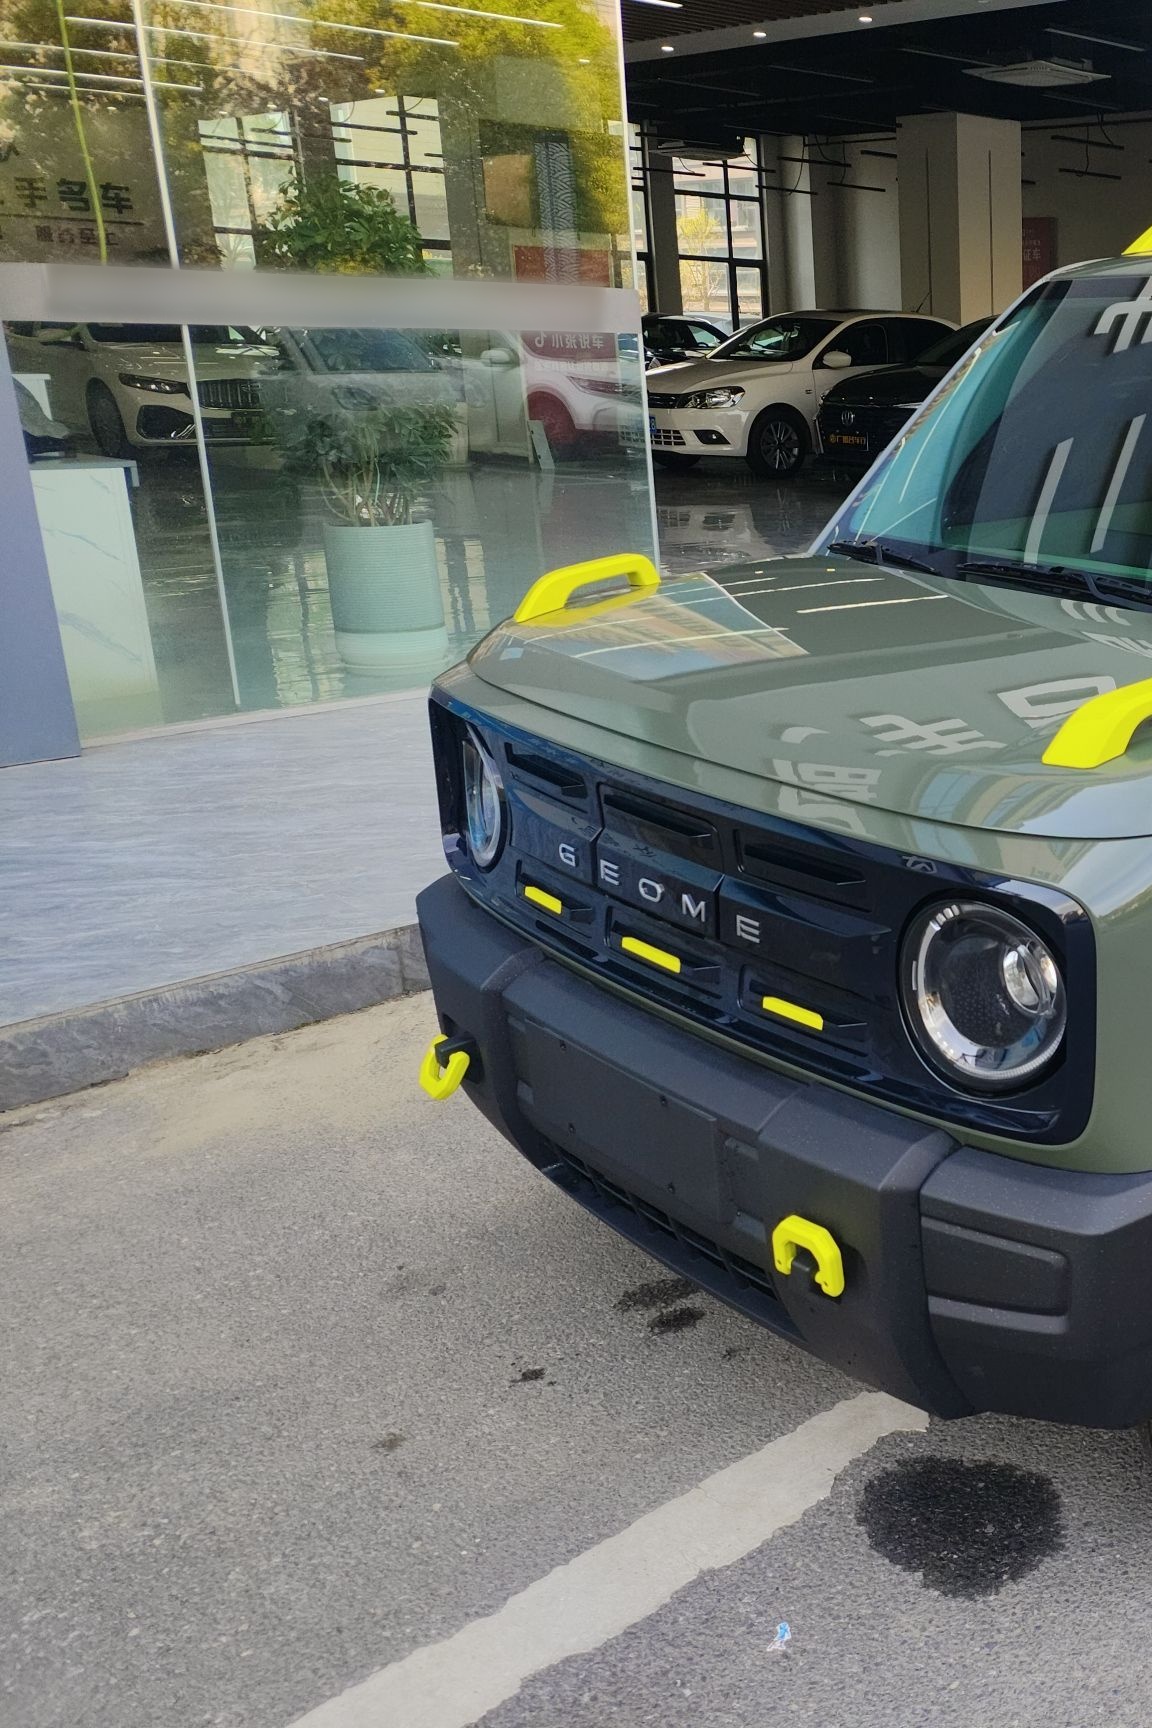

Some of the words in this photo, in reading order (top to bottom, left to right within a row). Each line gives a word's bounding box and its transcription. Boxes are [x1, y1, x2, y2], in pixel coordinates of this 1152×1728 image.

[0, 176, 134, 214] 手名车
[558, 842, 760, 944] GEOME
